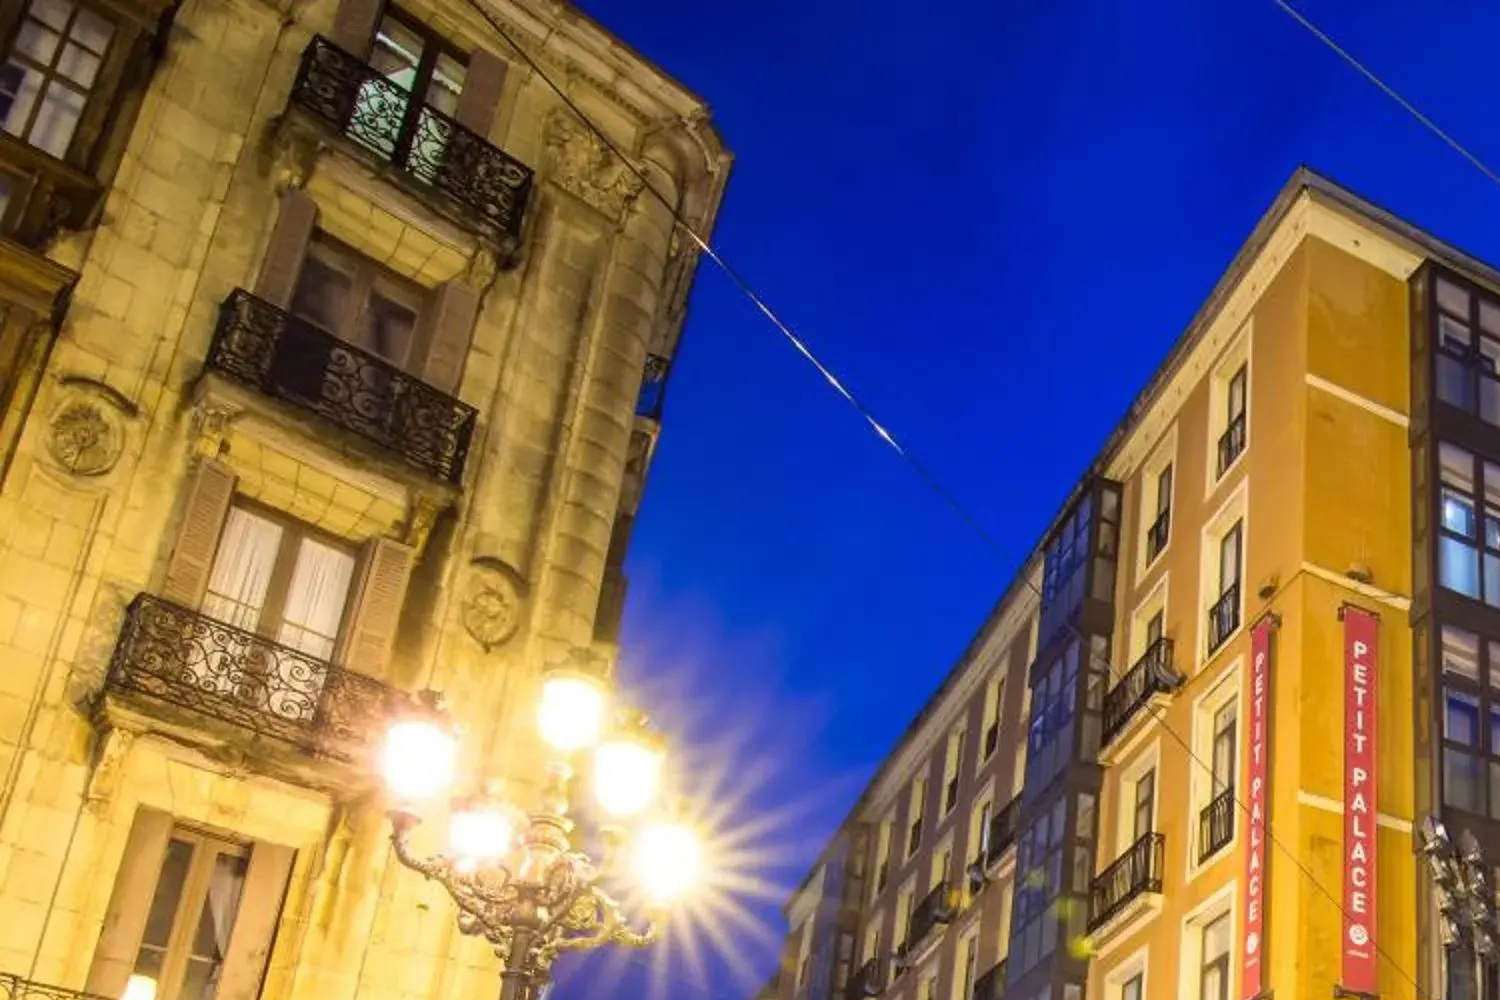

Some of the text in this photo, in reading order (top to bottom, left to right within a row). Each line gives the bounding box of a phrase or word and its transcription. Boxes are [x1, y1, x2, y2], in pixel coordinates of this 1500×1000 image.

[1249, 652, 1264, 922] PETIT PALACE
[1352, 640, 1367, 913] PETIT PALACE
